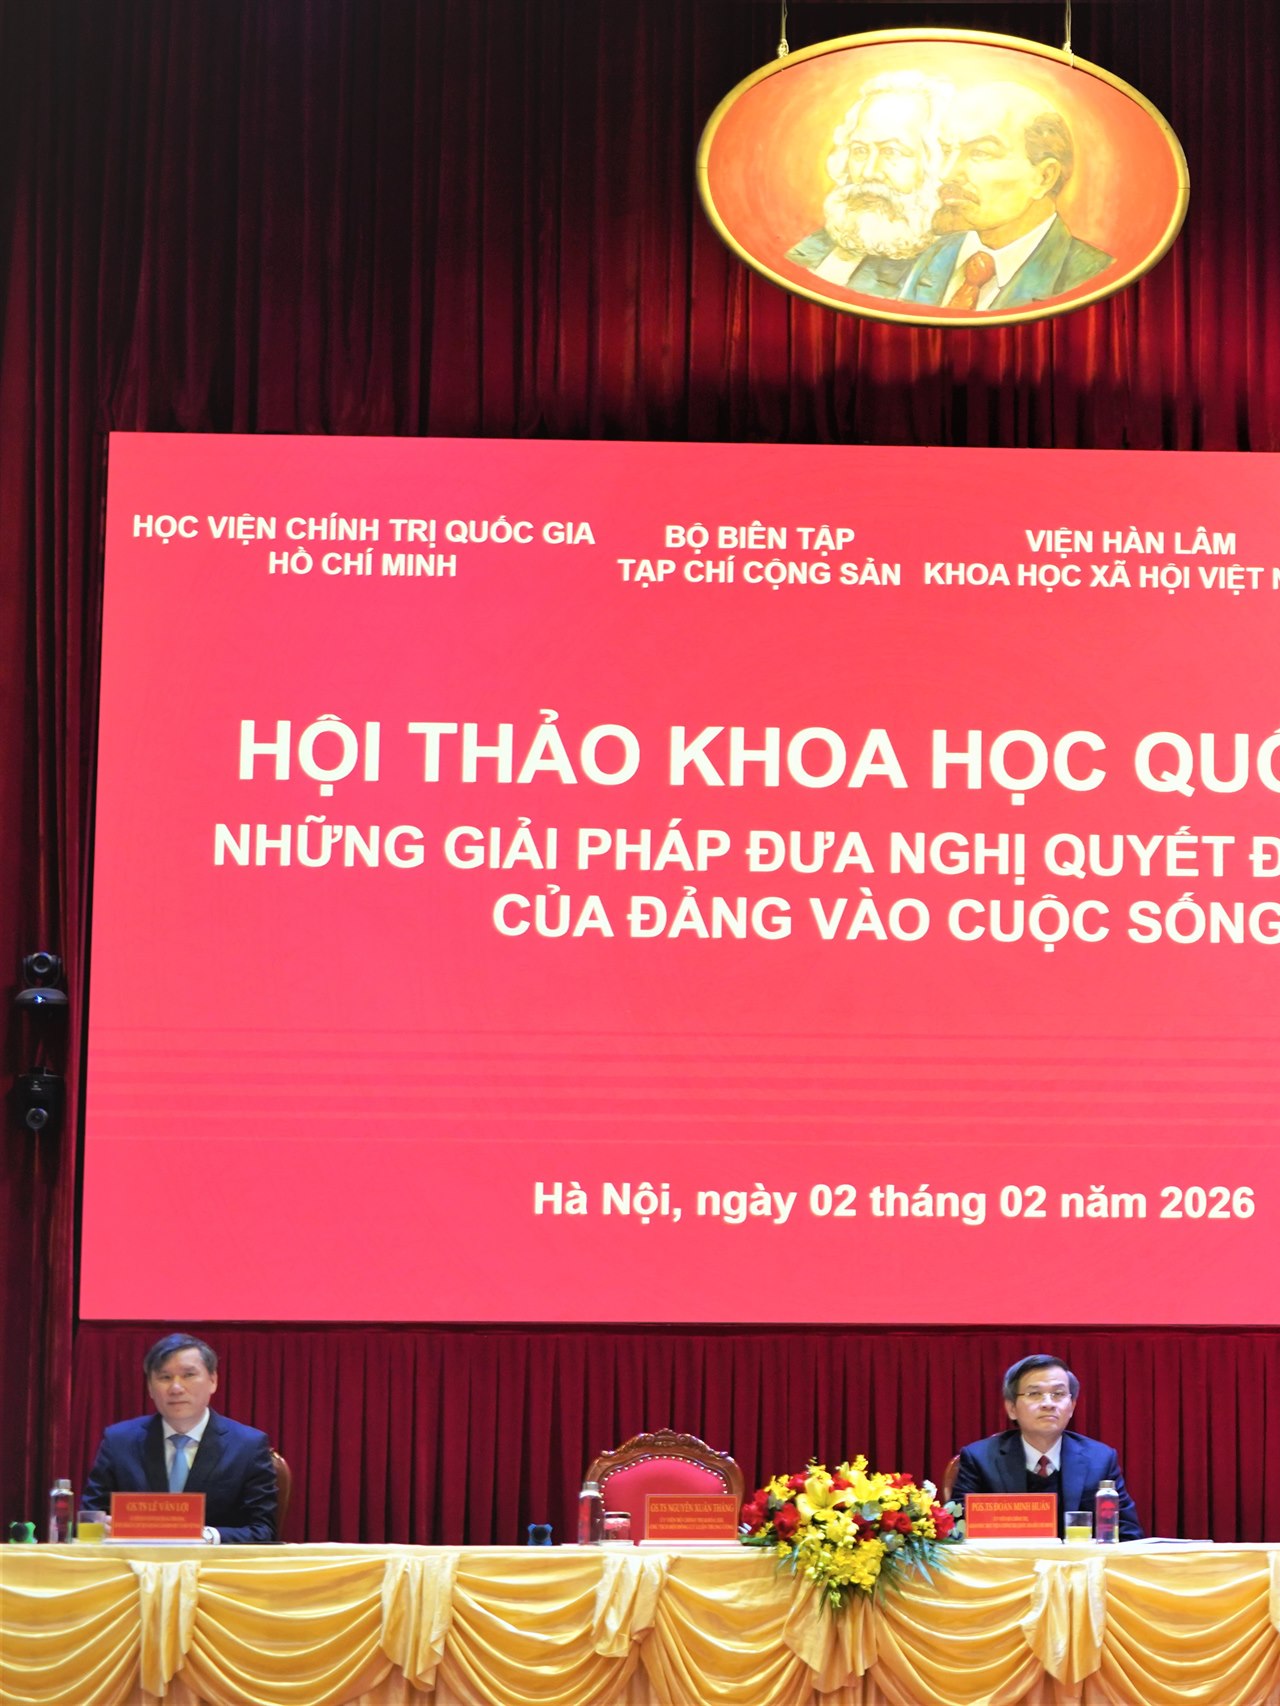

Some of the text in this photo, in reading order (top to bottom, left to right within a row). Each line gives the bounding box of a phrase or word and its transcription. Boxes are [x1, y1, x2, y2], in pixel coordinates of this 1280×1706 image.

[133, 512, 596, 549] HỌC VIỆN CHÍNH TRỊ QUỐC GIA
[665, 519, 855, 557] BỘ BIÊN TẬP
[1025, 525, 1236, 559] VIỆN HÀN LÂM
[268, 546, 457, 577] HỒ CHÍ MINH
[617, 554, 901, 591] TẠP CHÍ CỘNG SẢN
[924, 562, 1011, 586] KHOA
[1017, 563, 1082, 593] HỌC
[1089, 559, 1132, 588] XÃ
[1139, 562, 1190, 595] HỘI
[1197, 563, 1265, 596] VIỆT
[239, 713, 381, 797] HỘI
[407, 708, 641, 786] THẢO
[669, 725, 909, 789] KHOA
[931, 729, 1107, 806] HỌC
[214, 814, 425, 869] NHỮNG
[444, 816, 558, 870] GIẢI
[577, 817, 731, 872] PHÁP
[745, 830, 875, 874] ĐƯA
[890, 831, 1025, 886] NGHỊ
[1043, 825, 1236, 880] QUYẾT
[492, 883, 615, 938] CỦA
[626, 885, 792, 940] ĐẢNG
[809, 886, 930, 942] VÀO
[947, 893, 1110, 953] CUỘC
[534, 1181, 1255, 1226] Hà Nội, ngày 02 tháng 02 năm 2026
